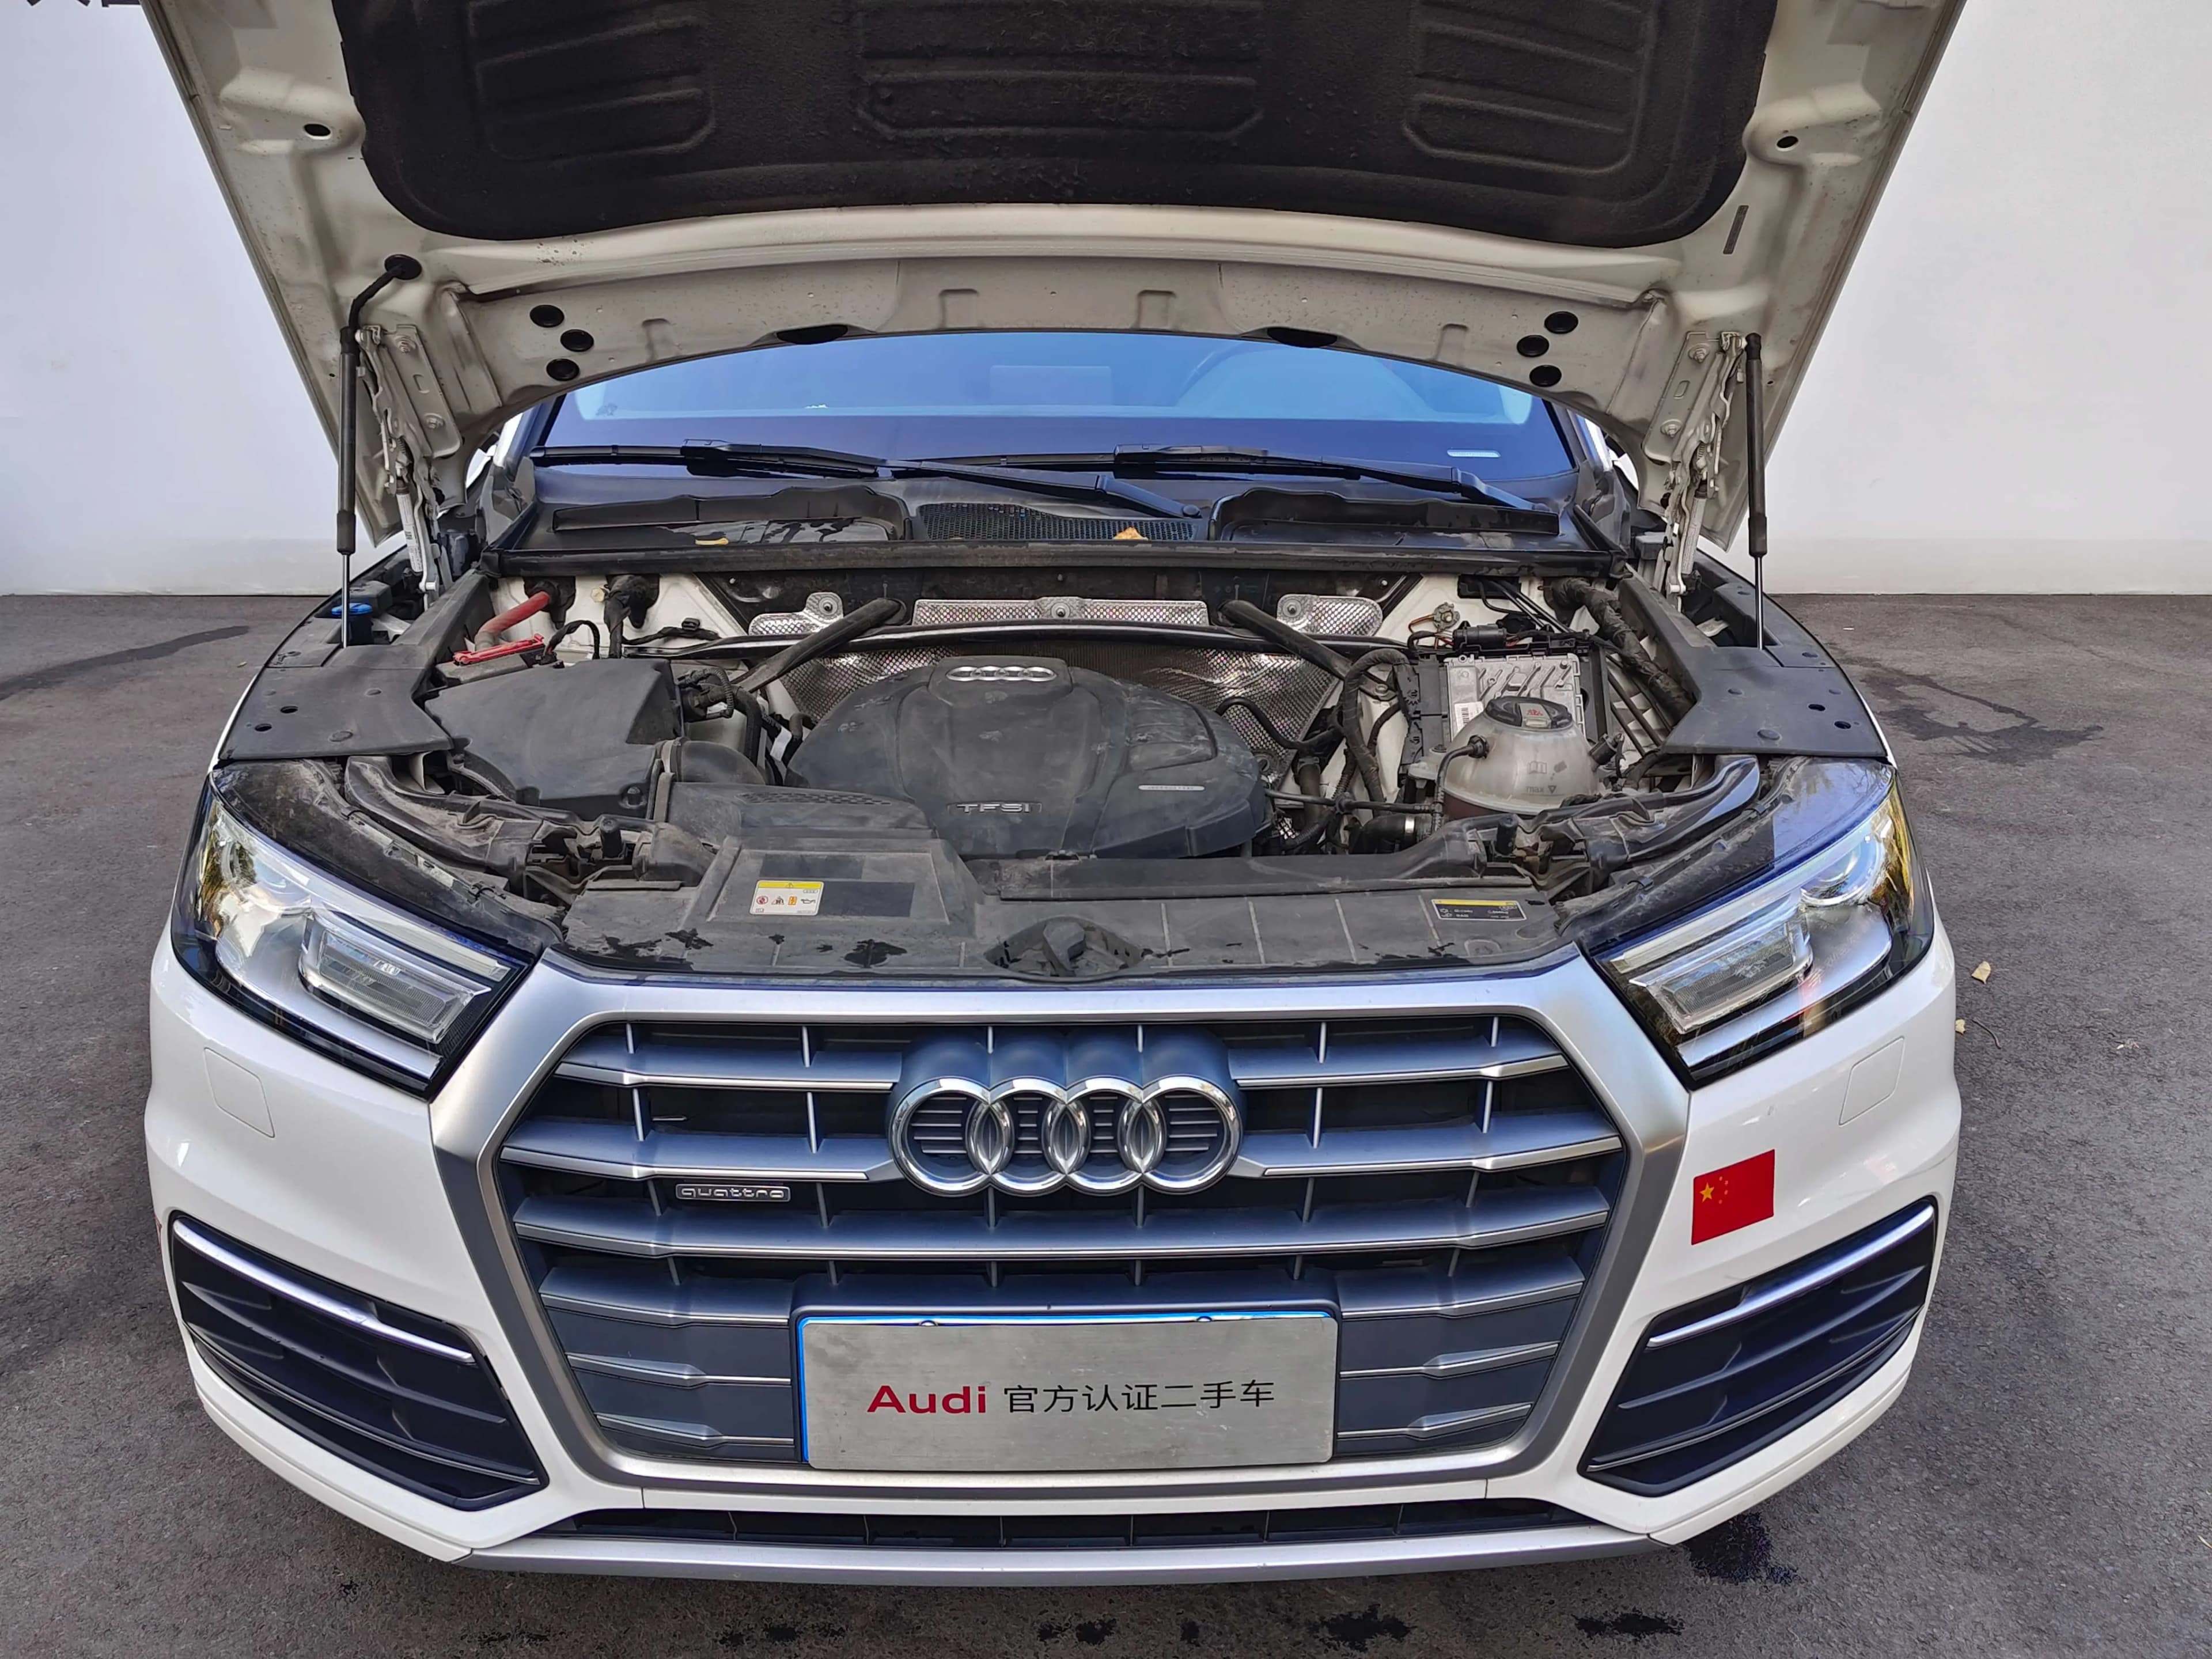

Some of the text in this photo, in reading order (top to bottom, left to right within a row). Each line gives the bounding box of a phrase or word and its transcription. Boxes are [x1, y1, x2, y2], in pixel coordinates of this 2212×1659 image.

[957, 803, 1030, 813] TFSI
[681, 1187, 784, 1198] quattro
[867, 1379, 1275, 1414] Audi 官方认证二手车
